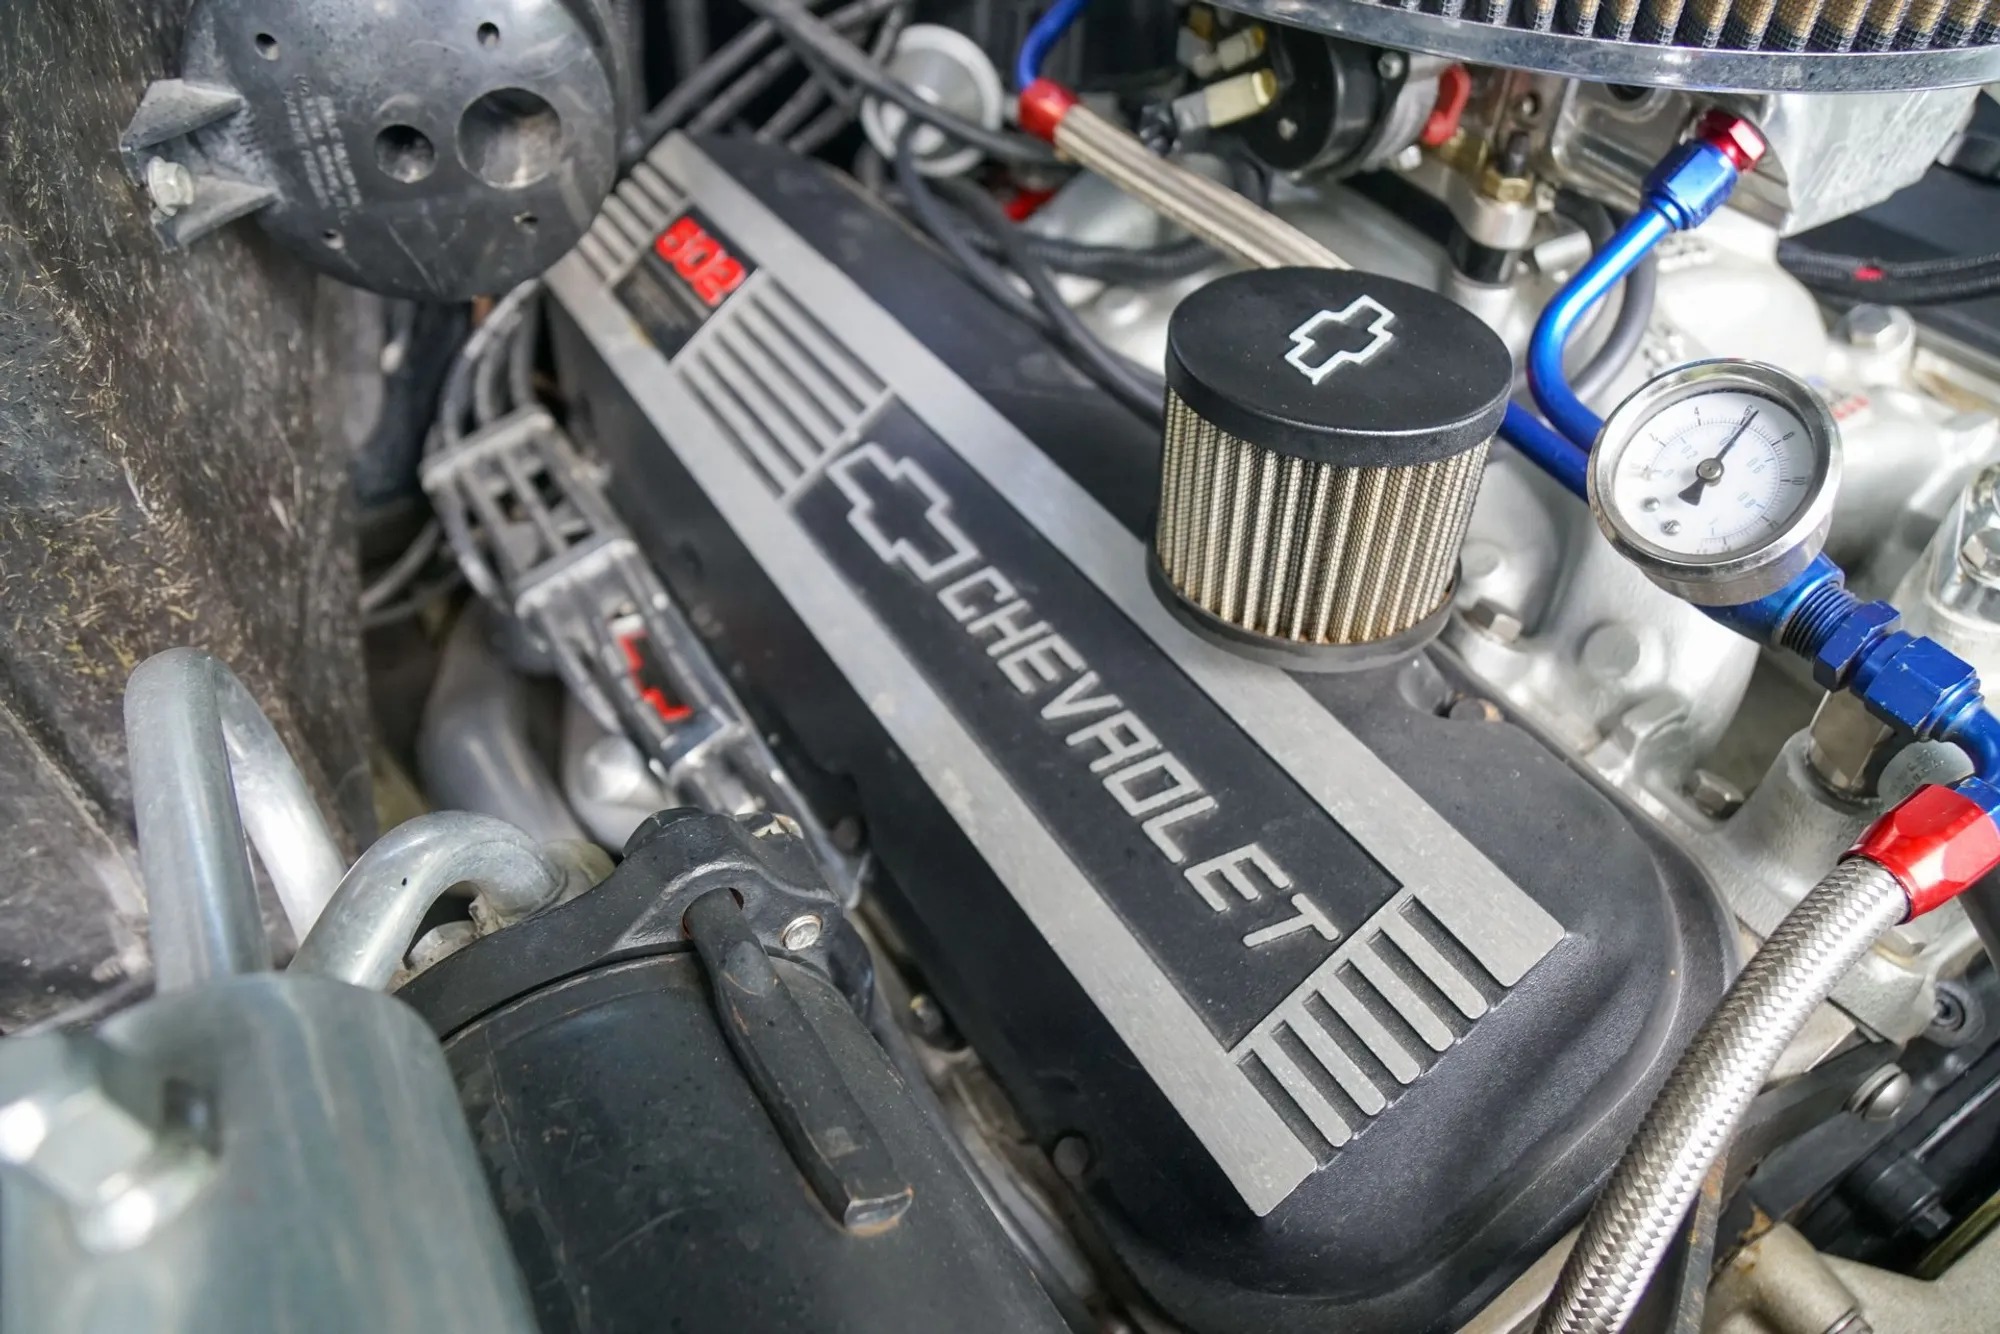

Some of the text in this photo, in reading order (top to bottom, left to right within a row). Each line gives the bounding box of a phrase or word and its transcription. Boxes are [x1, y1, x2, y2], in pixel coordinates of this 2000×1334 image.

[1743, 404, 1753, 416] 6
[1782, 431, 1795, 441] 8
[1791, 476, 1806, 486] 10
[936, 565, 1341, 949] CHEVROLET
